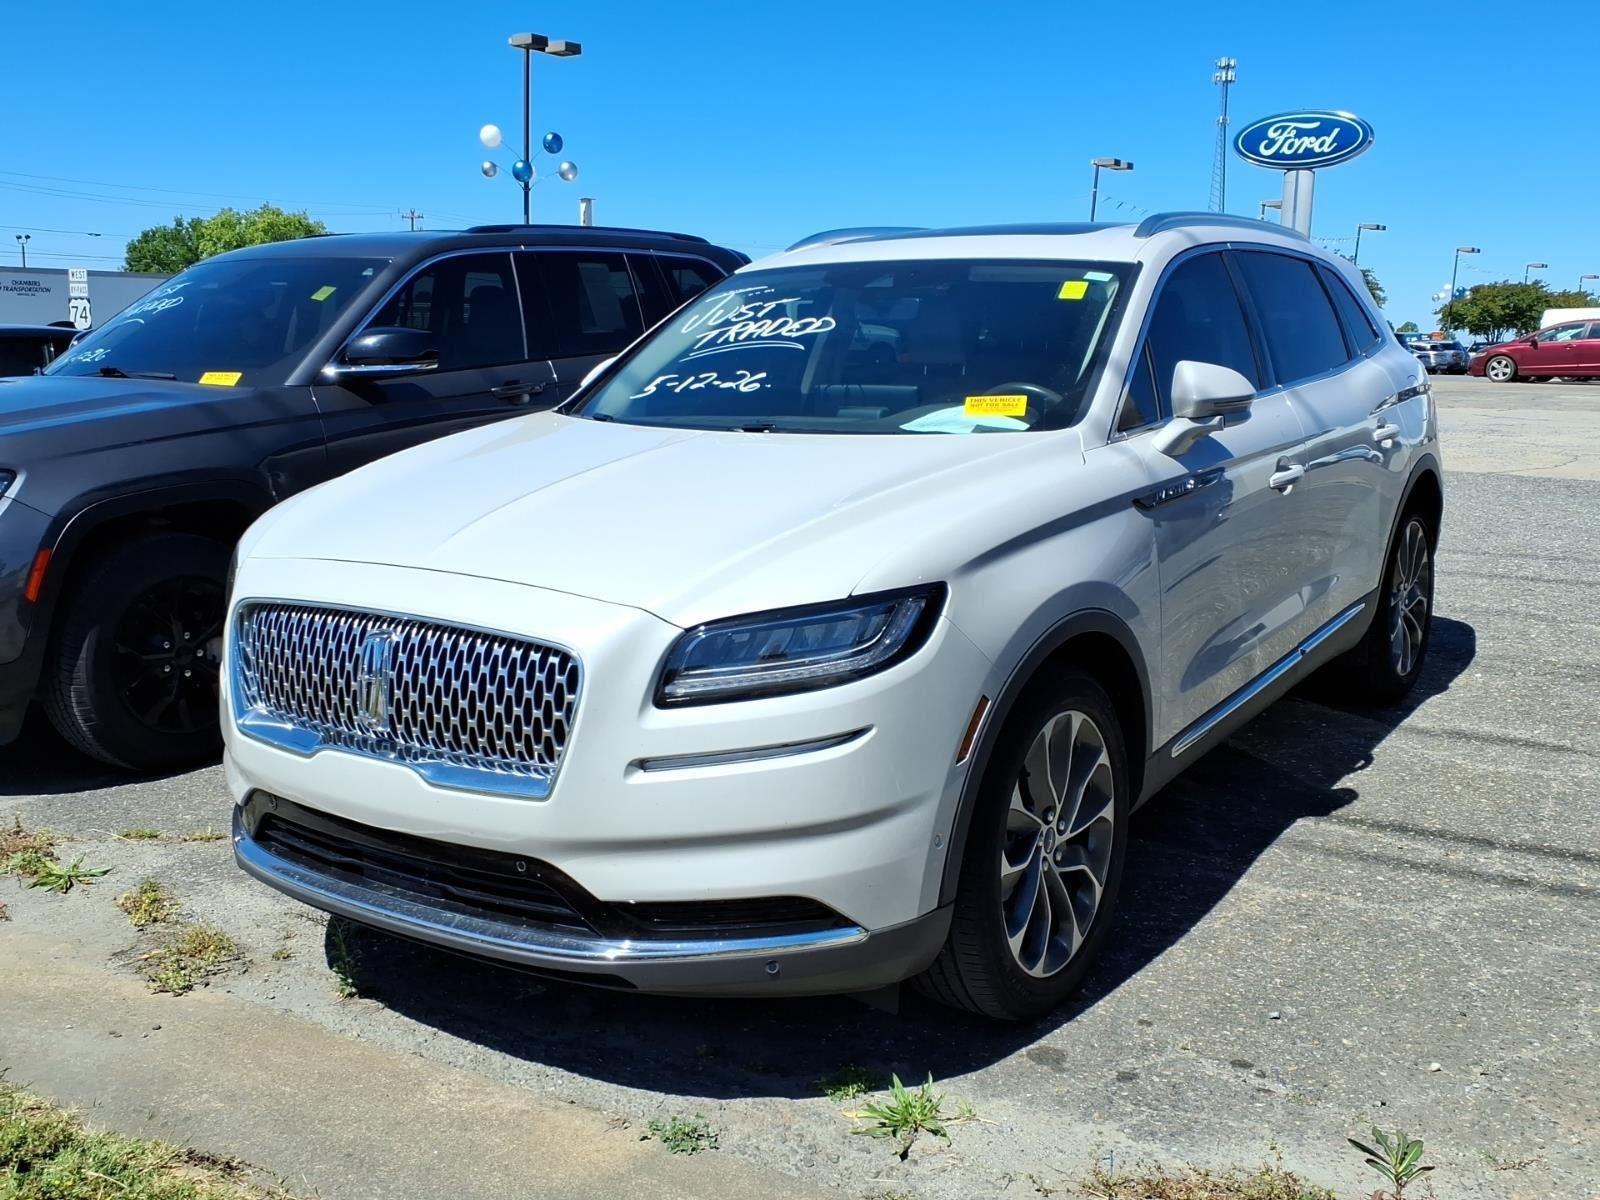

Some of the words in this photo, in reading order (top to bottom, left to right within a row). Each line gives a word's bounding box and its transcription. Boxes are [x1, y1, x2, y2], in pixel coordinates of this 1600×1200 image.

[1259, 121, 1341, 156] Ford
[71, 270, 86, 279] WEST
[71, 305, 88, 323] 74
[681, 286, 802, 334] JUST
[693, 316, 837, 350] TRADED
